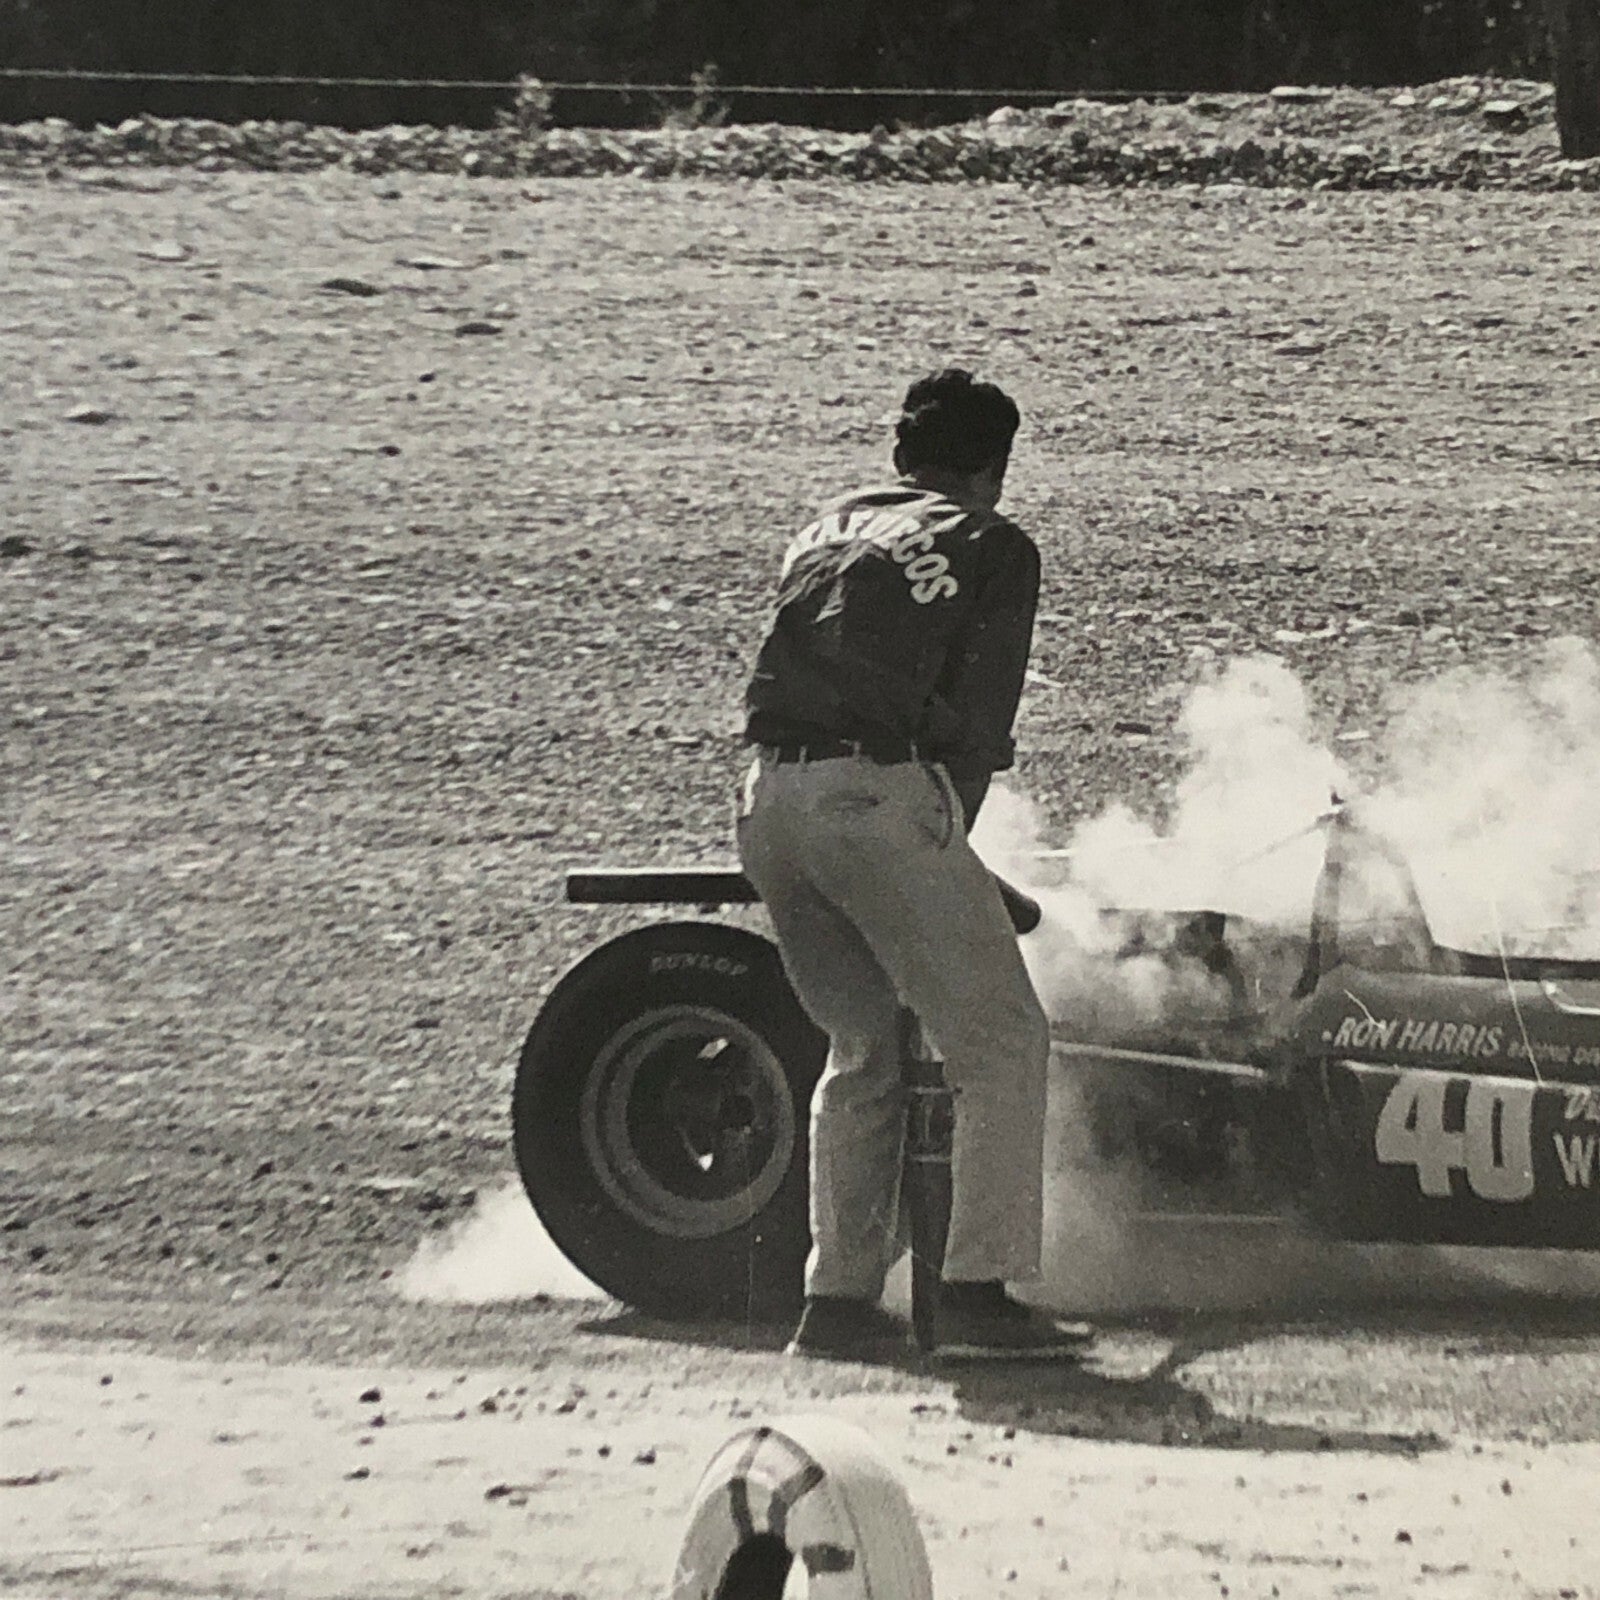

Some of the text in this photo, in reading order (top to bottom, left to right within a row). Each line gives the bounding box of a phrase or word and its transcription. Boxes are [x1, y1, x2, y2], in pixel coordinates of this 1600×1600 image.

[650, 952, 750, 975] DUNLOP
[1334, 1017, 1397, 1050] RON
[1397, 1018, 1503, 1058] HARRIS
[1375, 1071, 1536, 1202] 40
[1553, 1132, 1600, 1189] W
